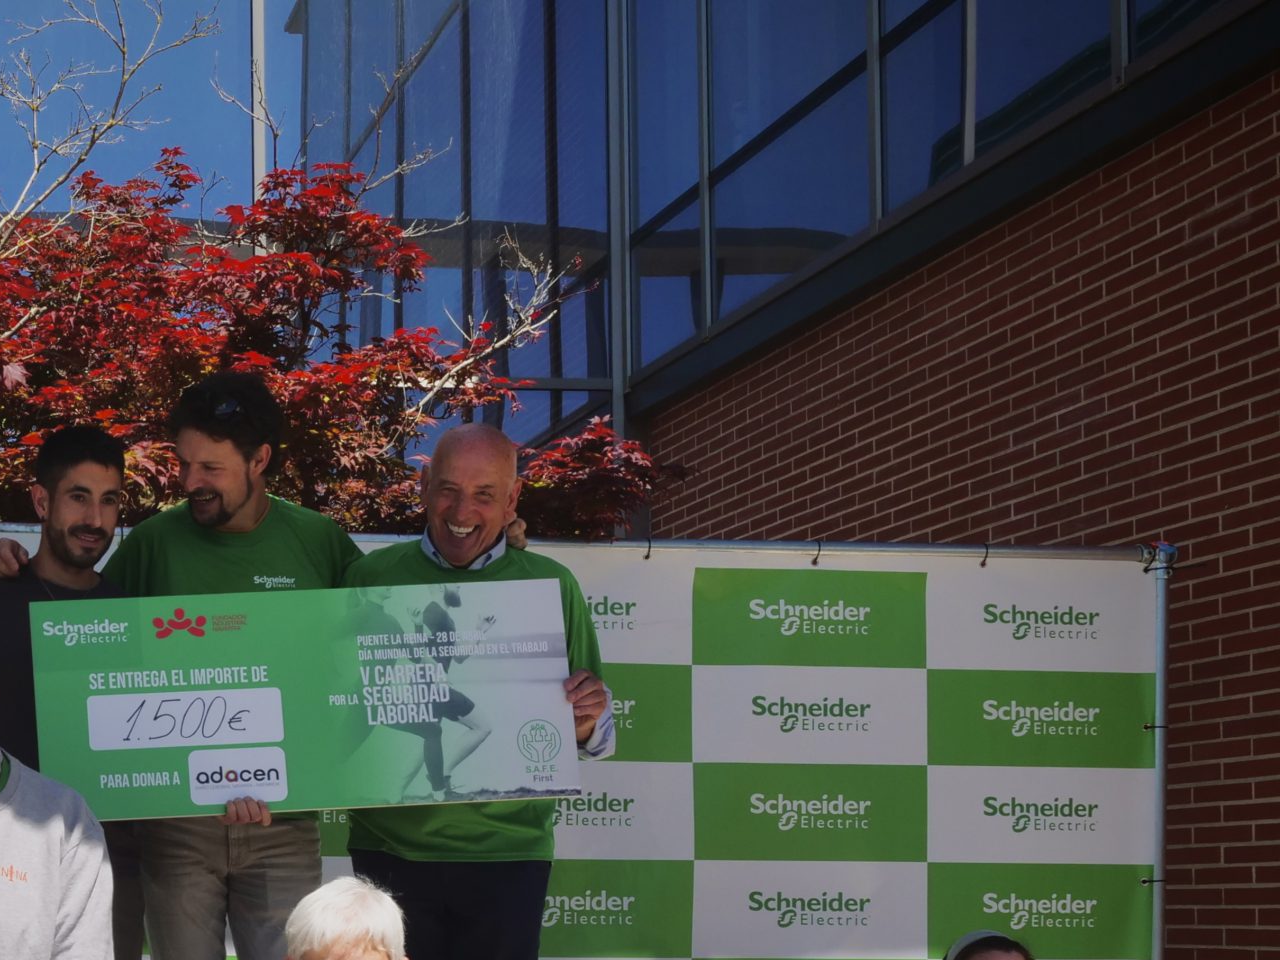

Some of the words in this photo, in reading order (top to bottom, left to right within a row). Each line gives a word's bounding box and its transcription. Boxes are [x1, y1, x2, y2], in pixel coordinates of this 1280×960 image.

[253, 575, 295, 585] Schneider
[749, 599, 871, 621] Schneider
[983, 603, 1100, 626] Schneider
[42, 619, 129, 637] Schneider
[592, 618, 635, 631] ctric
[803, 620, 869, 635] Electric
[1033, 626, 1098, 640] Electric
[80, 633, 128, 645] Electric
[357, 634, 390, 646] PUENTE
[391, 633, 402, 645] LA
[404, 632, 428, 644] REINA
[436, 631, 448, 643] 28
[375, 647, 412, 660] MUNDIAL
[414, 647, 426, 658] DE
[427, 646, 438, 658] LA
[439, 643, 486, 657] SEGURIDAD
[88, 673, 106, 690] SE
[109, 669, 169, 689] ENTREGA
[171, 668, 188, 686] EL
[190, 666, 249, 685] IMPORTE
[251, 665, 269, 682] DE
[360, 666, 370, 685] V
[374, 662, 448, 685] CARRERA
[328, 694, 346, 706] POR
[347, 693, 359, 705] LA
[362, 683, 450, 706] SEGURIDAD
[367, 703, 439, 725] LABORAL
[751, 695, 871, 718] Schneider
[982, 699, 1100, 722] Schneider
[802, 718, 870, 732] Electric
[1033, 722, 1098, 736] Electric
[100, 773, 130, 789] PARA
[132, 771, 170, 788] DONAR
[172, 770, 181, 785] A
[196, 765, 280, 785] adacen
[558, 792, 635, 812] neider
[750, 793, 872, 815] Schneider
[983, 796, 1099, 818] Schneider
[565, 813, 632, 827] Electric
[801, 815, 869, 829] Electric
[1033, 818, 1097, 832] Electric
[545, 890, 635, 911] neider
[748, 891, 871, 912] Schneider
[982, 893, 1097, 914] Schneider
[563, 911, 633, 926] Electric
[800, 913, 869, 927] Electric
[1031, 914, 1095, 928] Electric
